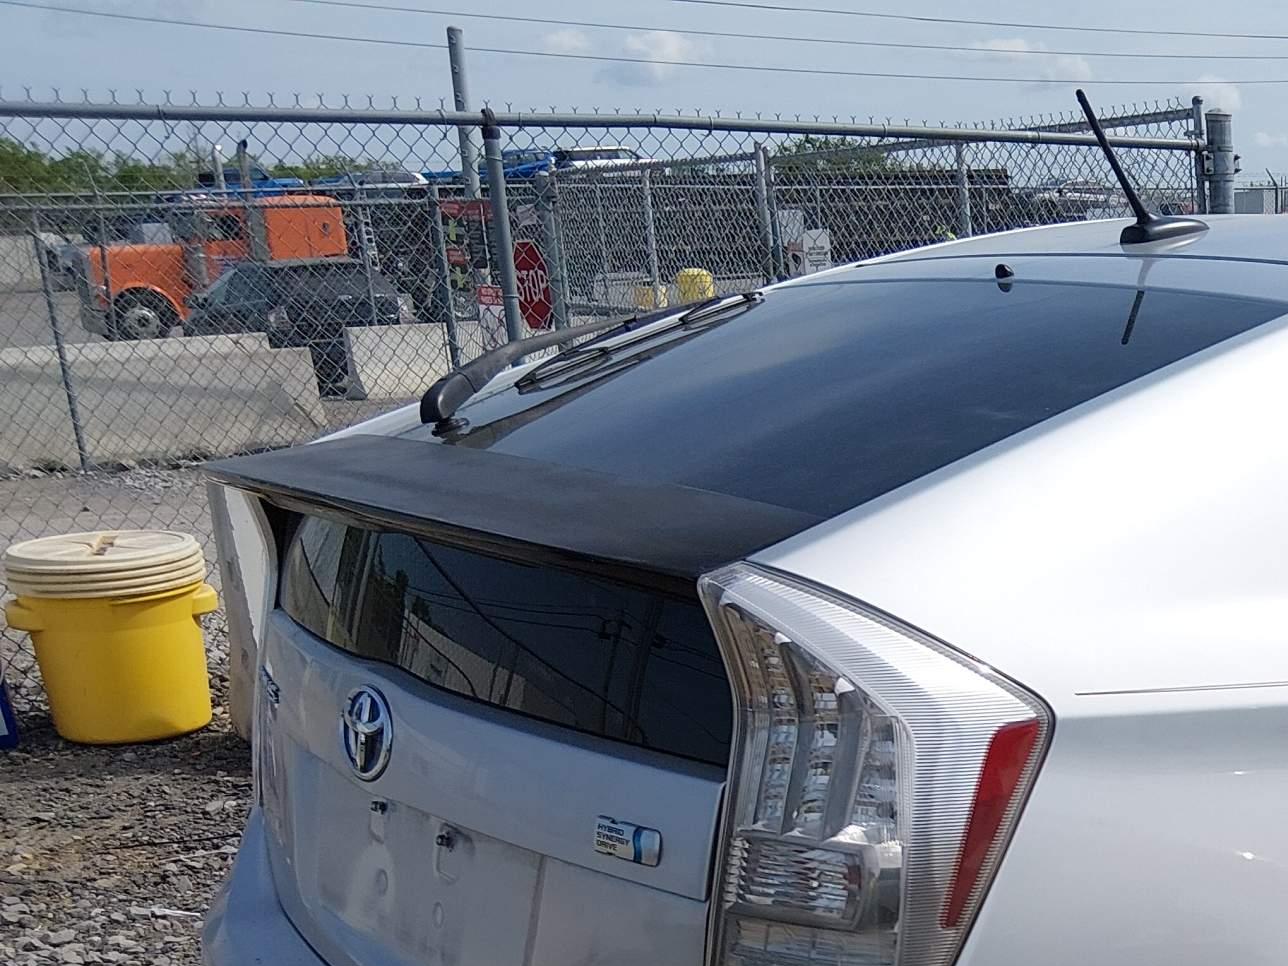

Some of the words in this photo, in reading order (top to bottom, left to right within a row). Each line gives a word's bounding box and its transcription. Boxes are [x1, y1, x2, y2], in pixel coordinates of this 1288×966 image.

[515, 269, 548, 302] STOP
[597, 823, 625, 836] HYBRID
[596, 831, 630, 846] SYNERGY
[596, 839, 618, 851] DRIVE
